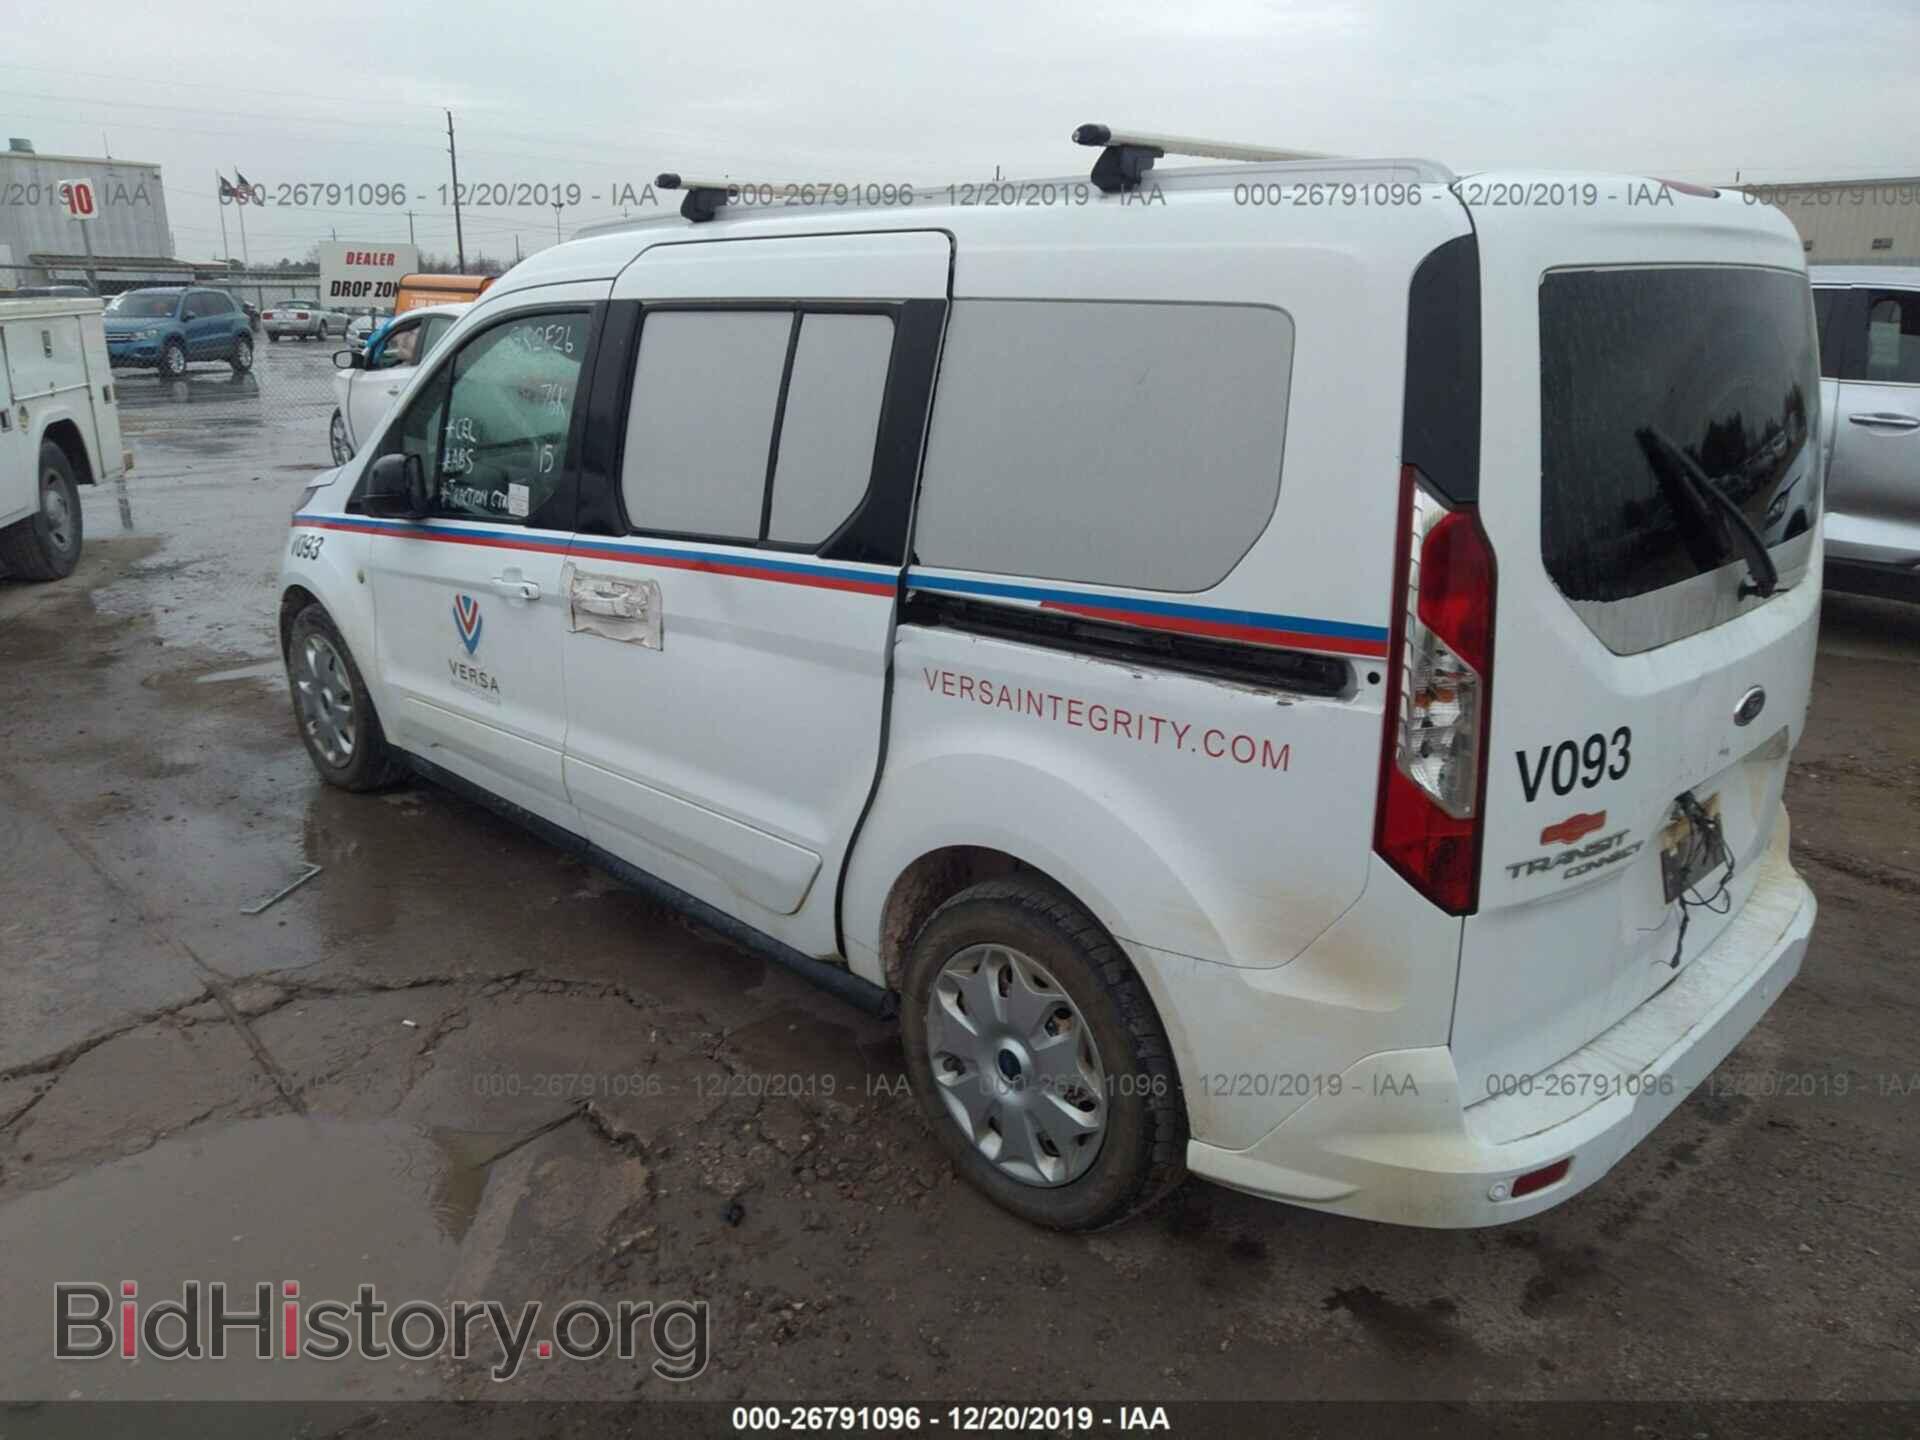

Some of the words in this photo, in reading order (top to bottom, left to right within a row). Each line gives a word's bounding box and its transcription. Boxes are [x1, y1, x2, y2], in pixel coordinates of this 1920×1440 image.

[64, 184, 94, 215] 10
[346, 251, 396, 266] DEALER
[330, 280, 373, 298] DROP
[374, 281, 401, 298] ZON
[448, 658, 501, 694] VERSA
[923, 667, 1291, 772] VERSAINTEGRITY.COM
[1515, 726, 1632, 803] V093
[1505, 828, 1631, 880] TRANSIT
